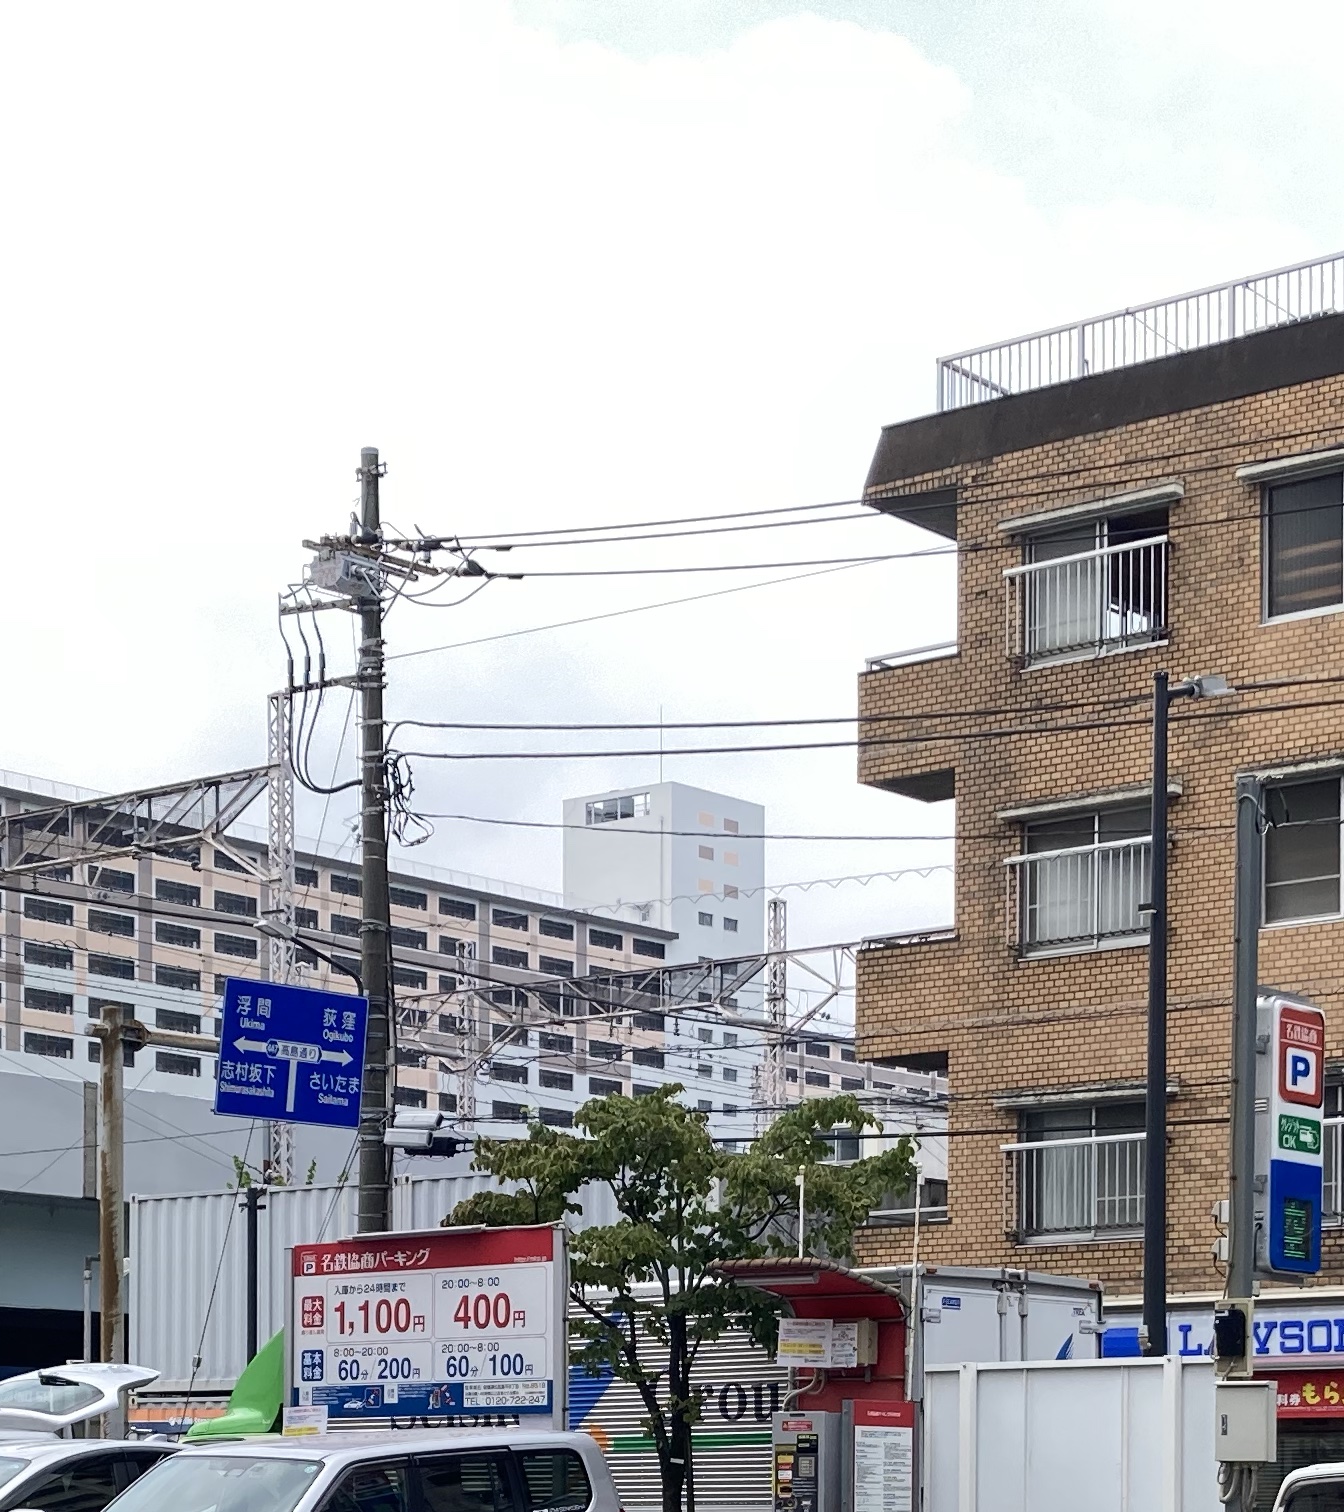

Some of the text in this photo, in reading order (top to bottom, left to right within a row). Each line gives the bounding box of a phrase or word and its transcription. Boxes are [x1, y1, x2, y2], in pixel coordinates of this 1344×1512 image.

[236, 995, 272, 1019] 浮間
[240, 1017, 265, 1031] Ukima
[323, 1008, 356, 1031] 荻窪
[323, 1029, 354, 1043] Ogikubo
[280, 1044, 318, 1060] 高島通り
[221, 1060, 277, 1084] 志村坂下
[1292, 1054, 1310, 1086] P
[309, 1072, 360, 1094] さいたま
[317, 1093, 349, 1107] Saitama
[1282, 1134, 1296, 1149] OK
[320, 1248, 431, 1272] 名鉄協商パーキング
[334, 1282, 406, 1295] 入庫から24時間まで
[303, 1299, 323, 1312] 最大
[453, 1292, 526, 1329] 400円
[303, 1312, 323, 1326] 料金
[334, 1298, 425, 1336] 1,100円
[303, 1352, 323, 1365] 基本
[303, 1366, 323, 1380] 料金
